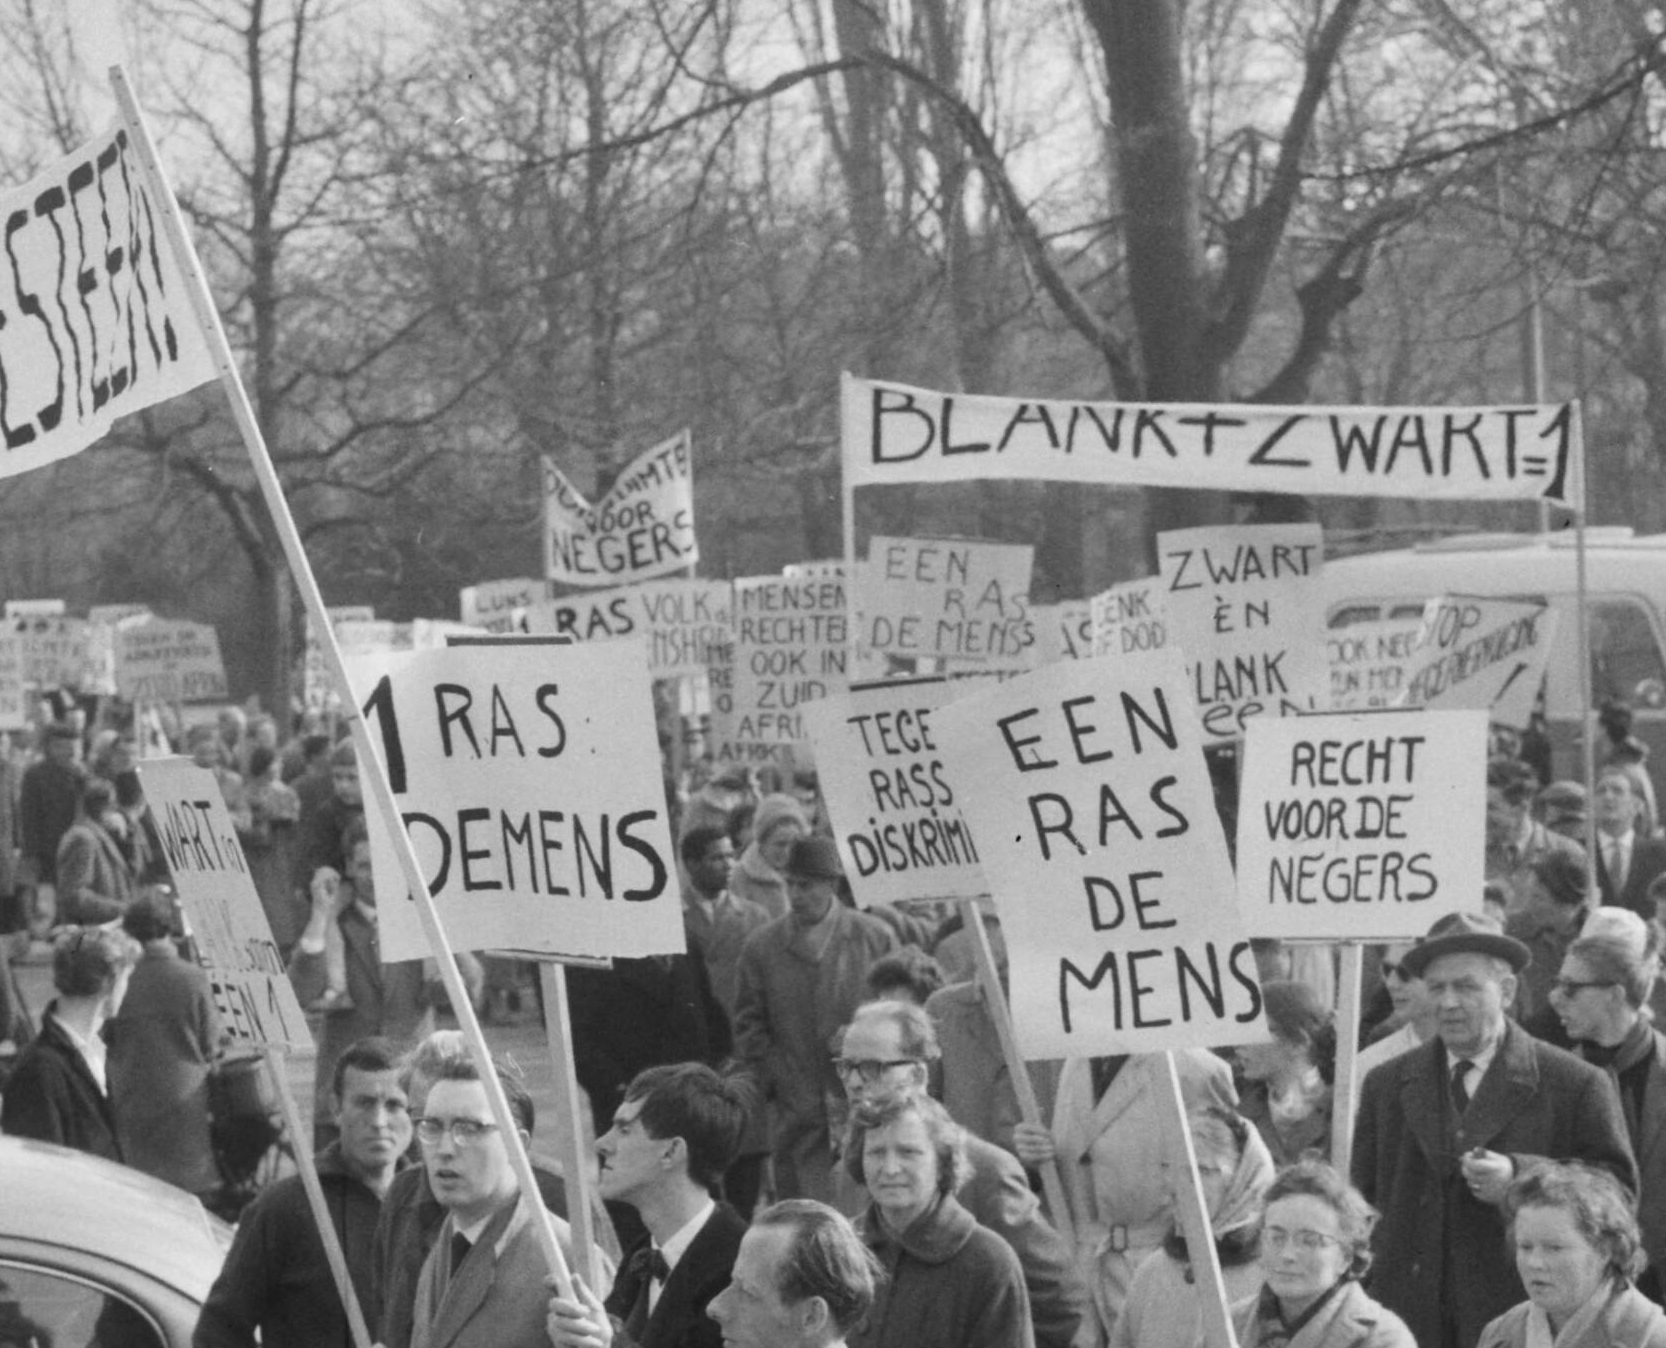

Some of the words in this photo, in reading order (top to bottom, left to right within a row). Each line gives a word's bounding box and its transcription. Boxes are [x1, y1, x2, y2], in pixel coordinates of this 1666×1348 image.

[886, 547, 969, 585] EEN
[1167, 545, 1316, 592] ZWART
[555, 599, 635, 641] RAS
[944, 579, 1026, 623] RAS
[871, 616, 921, 648] DE
[750, 649, 806, 676] OOK
[821, 650, 846, 674] IN
[1186, 651, 1289, 704] LANK
[362, 674, 408, 795] 1
[434, 682, 567, 759] RAS
[736, 714, 808, 739] AFRI
[997, 687, 1179, 773] EEN
[869, 760, 954, 812] RASS
[1290, 736, 1427, 788] RECHT
[1028, 775, 1190, 861] RAS
[1083, 870, 1178, 932] DE
[1268, 851, 1439, 904] NEGERS
[1059, 941, 1262, 1034] MENS
